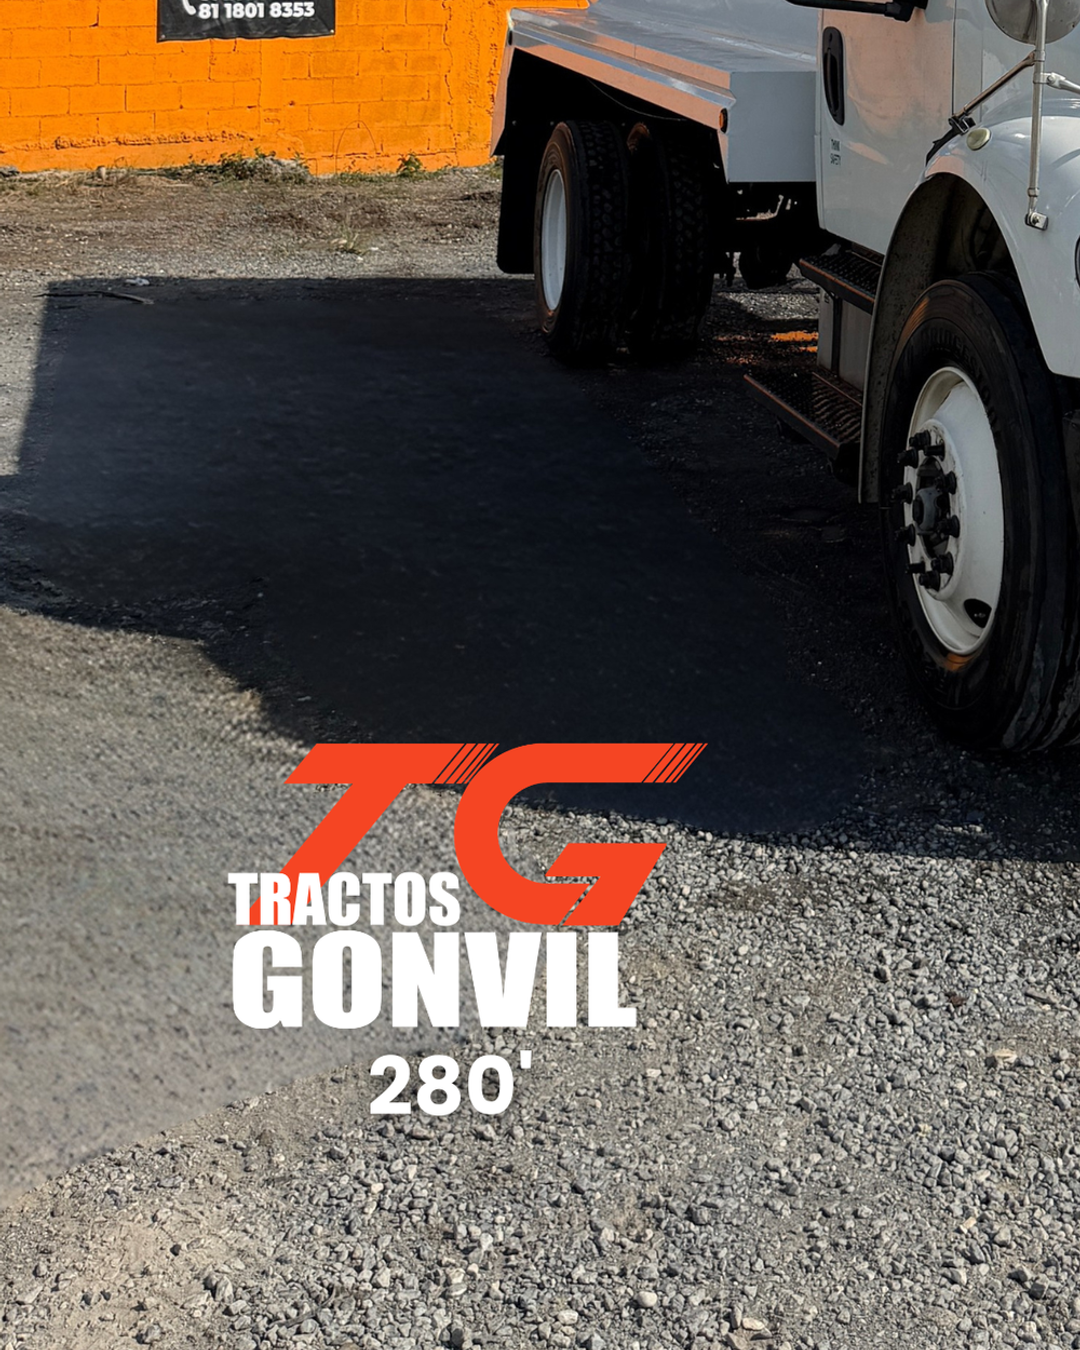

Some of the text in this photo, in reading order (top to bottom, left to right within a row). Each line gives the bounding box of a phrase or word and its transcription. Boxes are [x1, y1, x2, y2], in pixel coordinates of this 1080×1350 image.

[199, 2, 315, 19] 81 1801 8353
